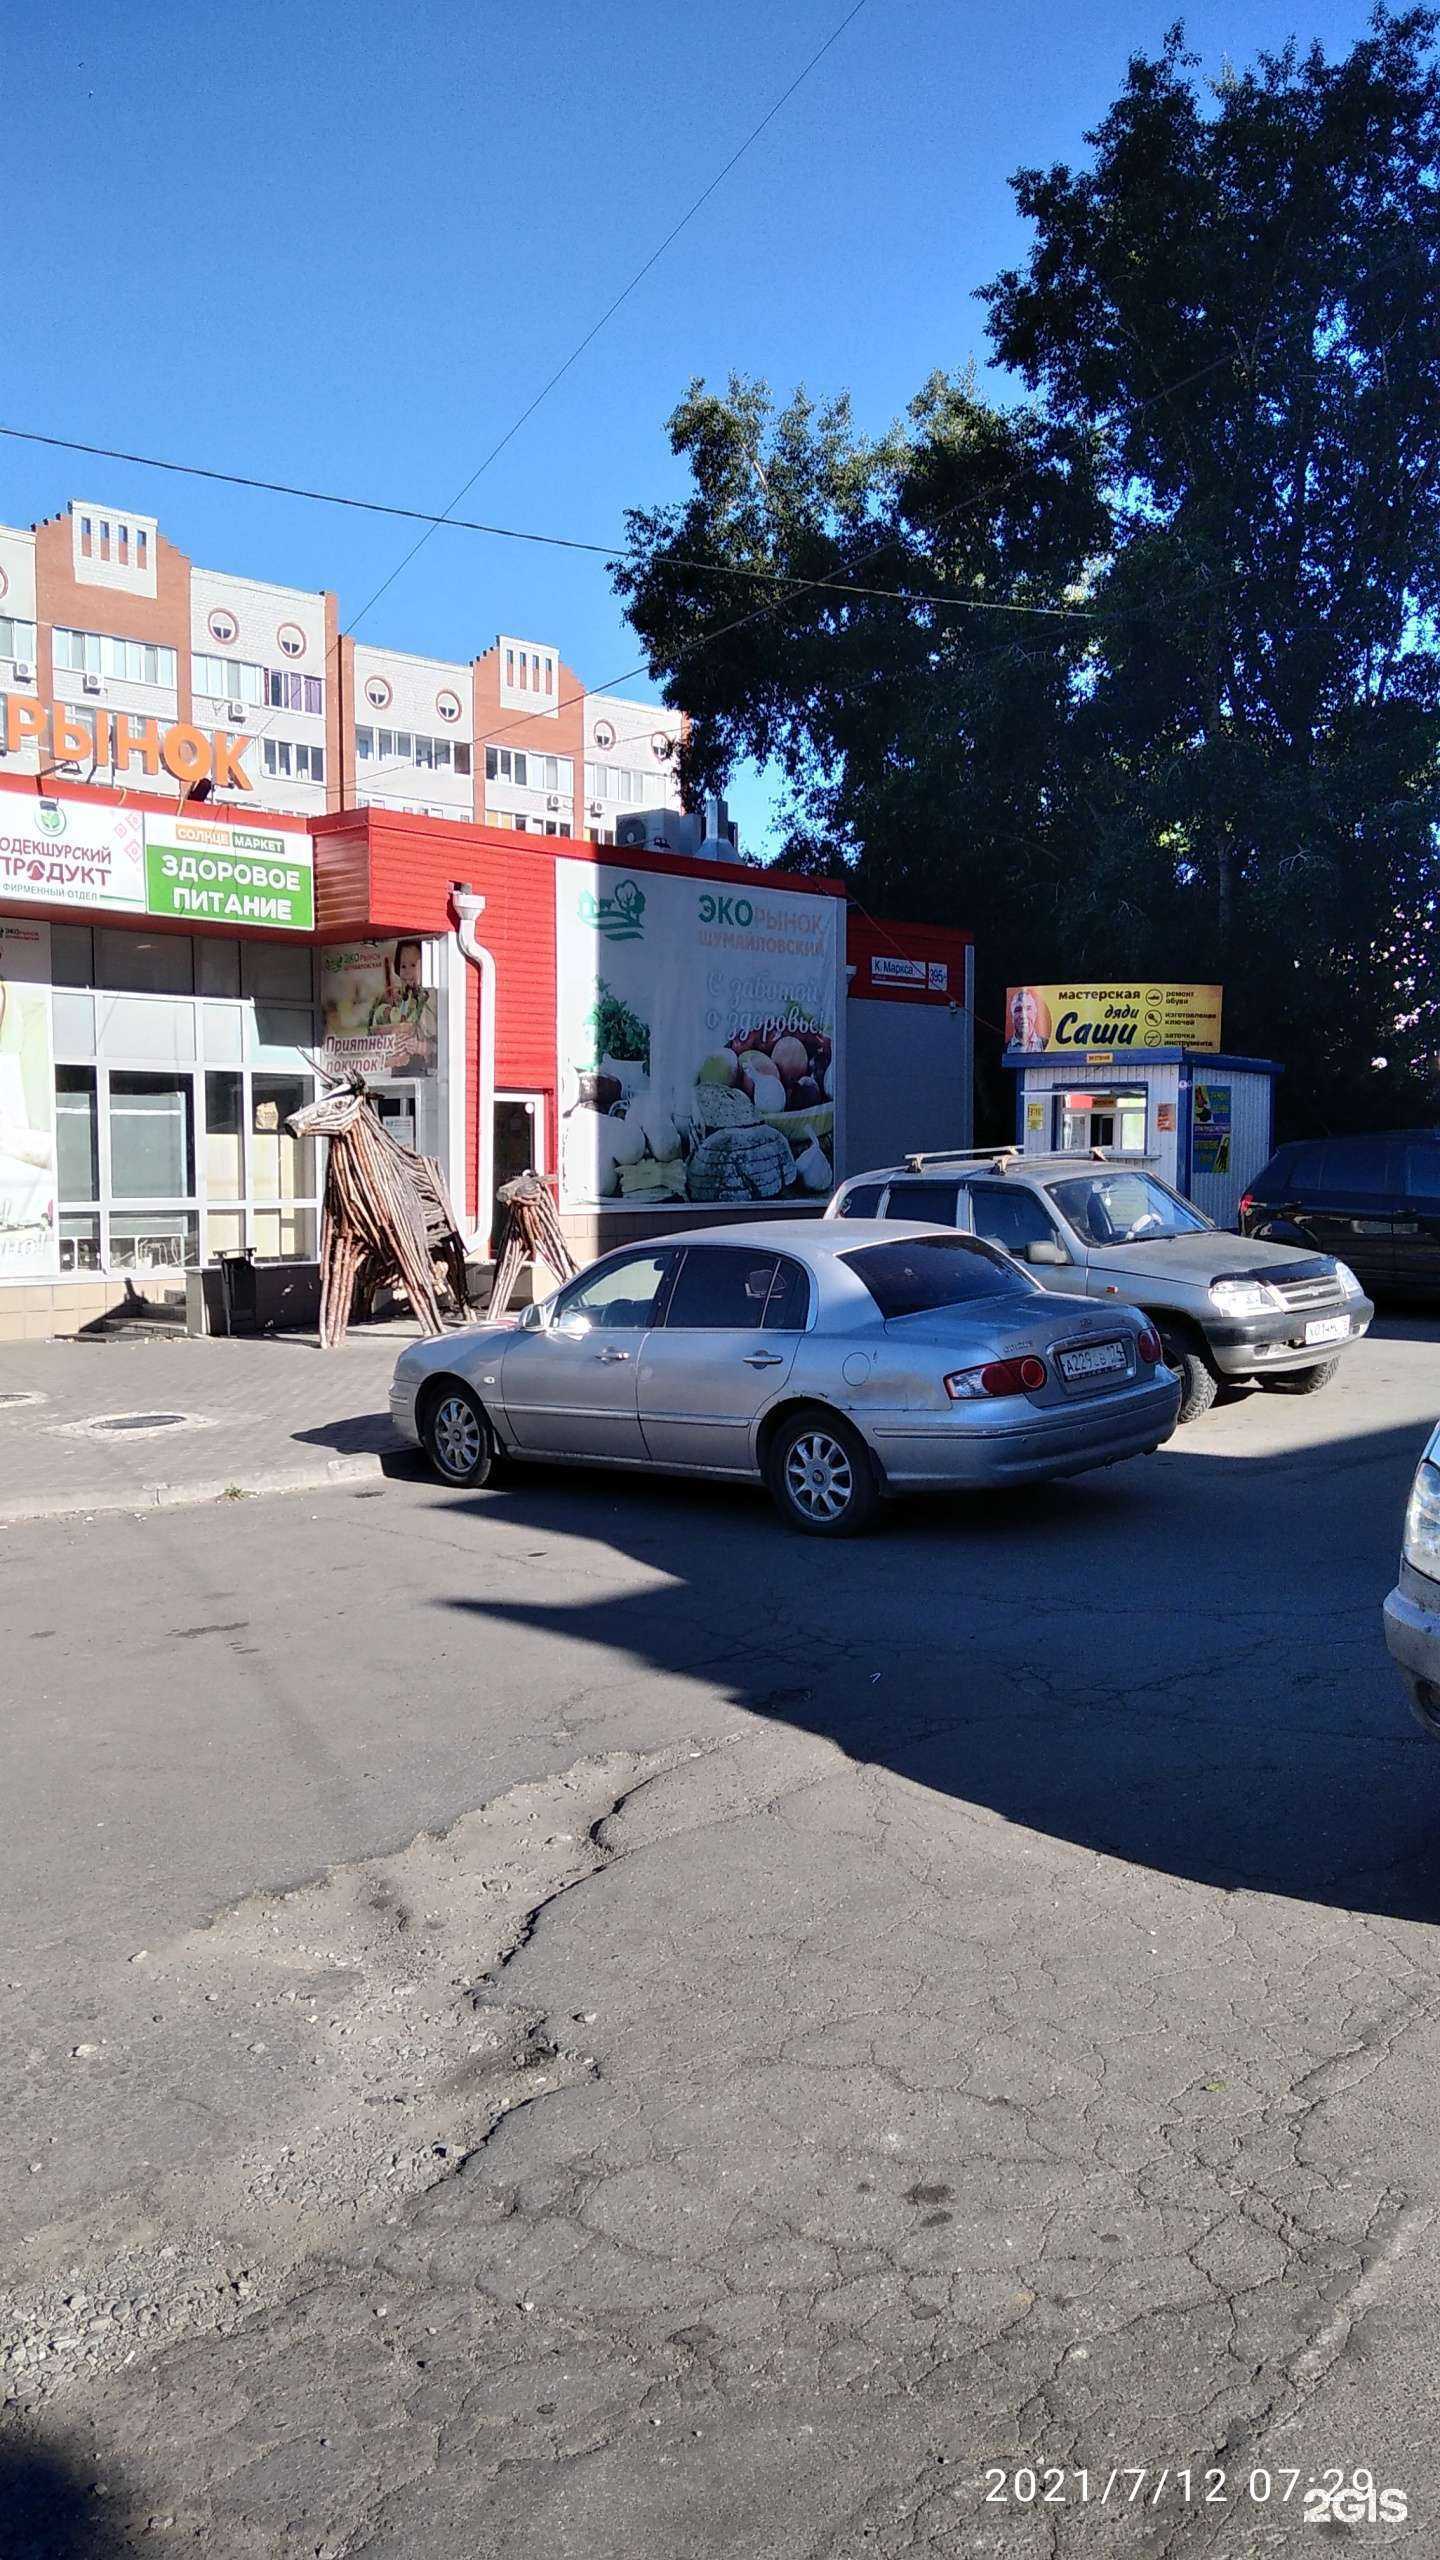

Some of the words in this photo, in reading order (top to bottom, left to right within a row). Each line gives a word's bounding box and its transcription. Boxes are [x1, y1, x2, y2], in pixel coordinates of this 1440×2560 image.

[7, 692, 253, 792] РЫНОК
[178, 828, 230, 846] СОЛНЦЕ
[234, 835, 283, 853] МАРКЕТ
[161, 854, 302, 892] ЗДОРОВОЕ
[2, 882, 65, 898] ФИРМЕННЫЙ
[67, 889, 98, 901] ОТДЕЛ
[173, 887, 292, 921] ПИТАНИЕ
[1058, 989, 1141, 1002] мастерская
[1104, 1004, 1140, 1019] дяди
[1055, 1011, 1138, 1045] Саши
[326, 1036, 395, 1055] Приятных
